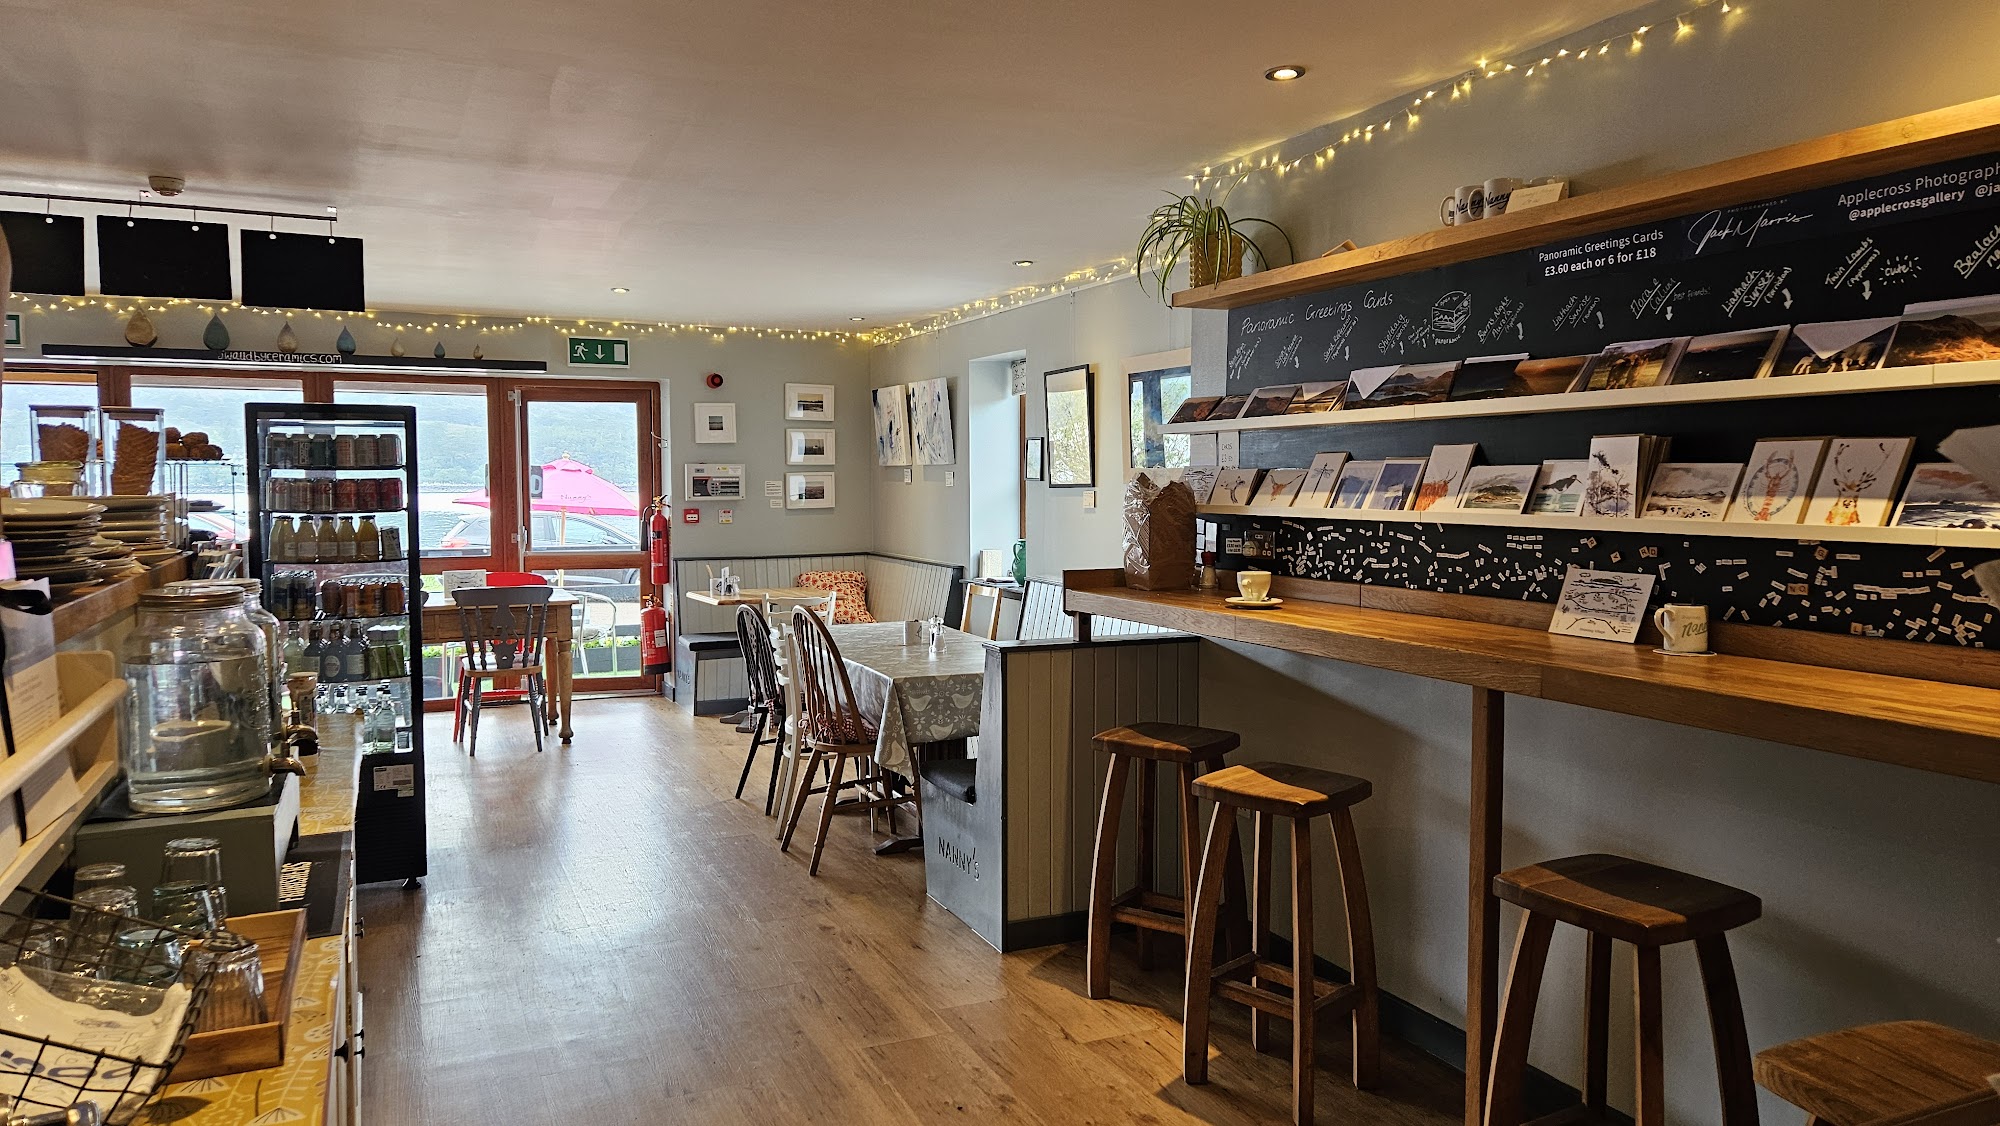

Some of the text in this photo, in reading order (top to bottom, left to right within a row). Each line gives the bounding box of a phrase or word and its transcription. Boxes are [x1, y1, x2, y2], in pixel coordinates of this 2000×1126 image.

[1837, 182, 1911, 207] Applecross
[1849, 190, 1965, 221] @applecrossgallery
[1539, 229, 1664, 262] Panoramic Greetings Cards
[1544, 247, 1657, 277] £3.60 each or 6 for £18
[1824, 237, 1873, 285] Twin Lambs
[1630, 289, 1654, 316] Flora
[1721, 270, 1760, 313] Liathach
[1743, 270, 1774, 307] Sunset
[1240, 289, 1394, 337] Panoramic Greetings Cards
[1477, 296, 1510, 343] Burns Night
[1491, 310, 1513, 338] Aurora
[1552, 295, 1578, 327] Liathach
[1569, 295, 1592, 324] Sunrise
[1378, 314, 1407, 353] Shieldaig
[938, 836, 980, 881] NANNY'S
